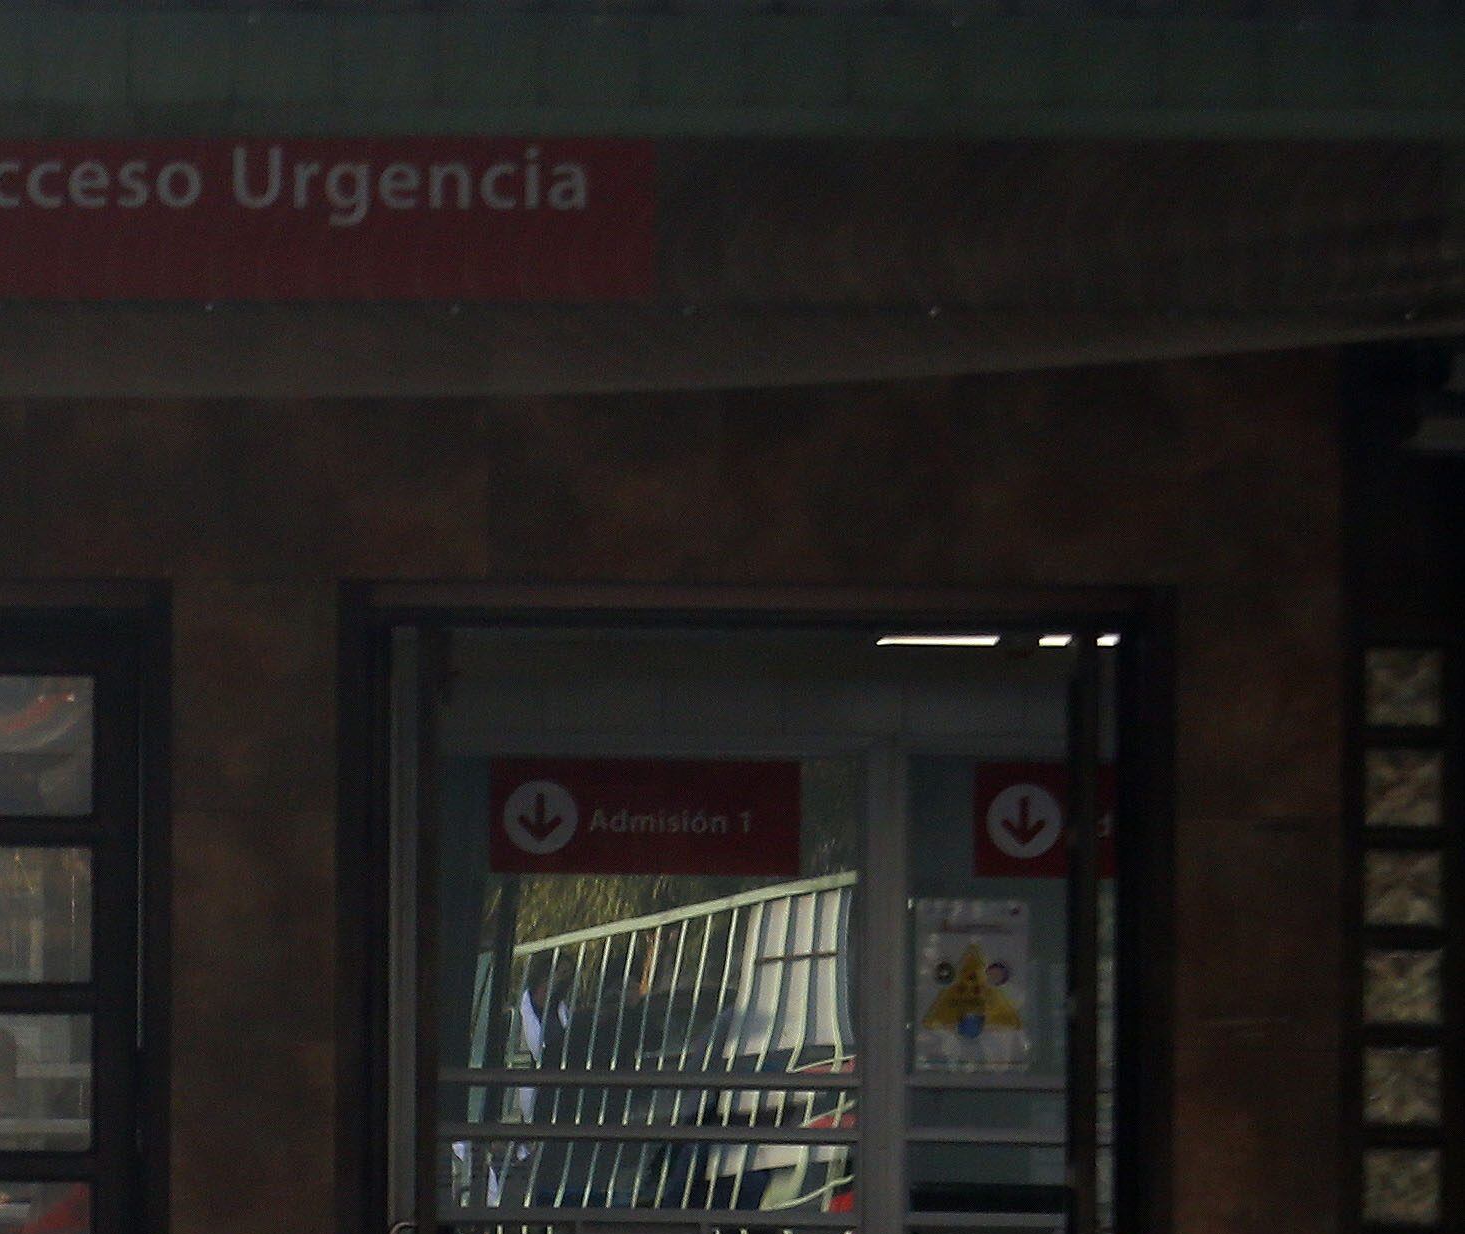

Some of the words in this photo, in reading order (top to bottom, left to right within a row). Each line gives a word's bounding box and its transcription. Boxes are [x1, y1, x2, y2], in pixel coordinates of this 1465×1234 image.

[231, 145, 590, 228] Urgencia
[589, 806, 728, 835] Admisión
[739, 810, 752, 834] 1
